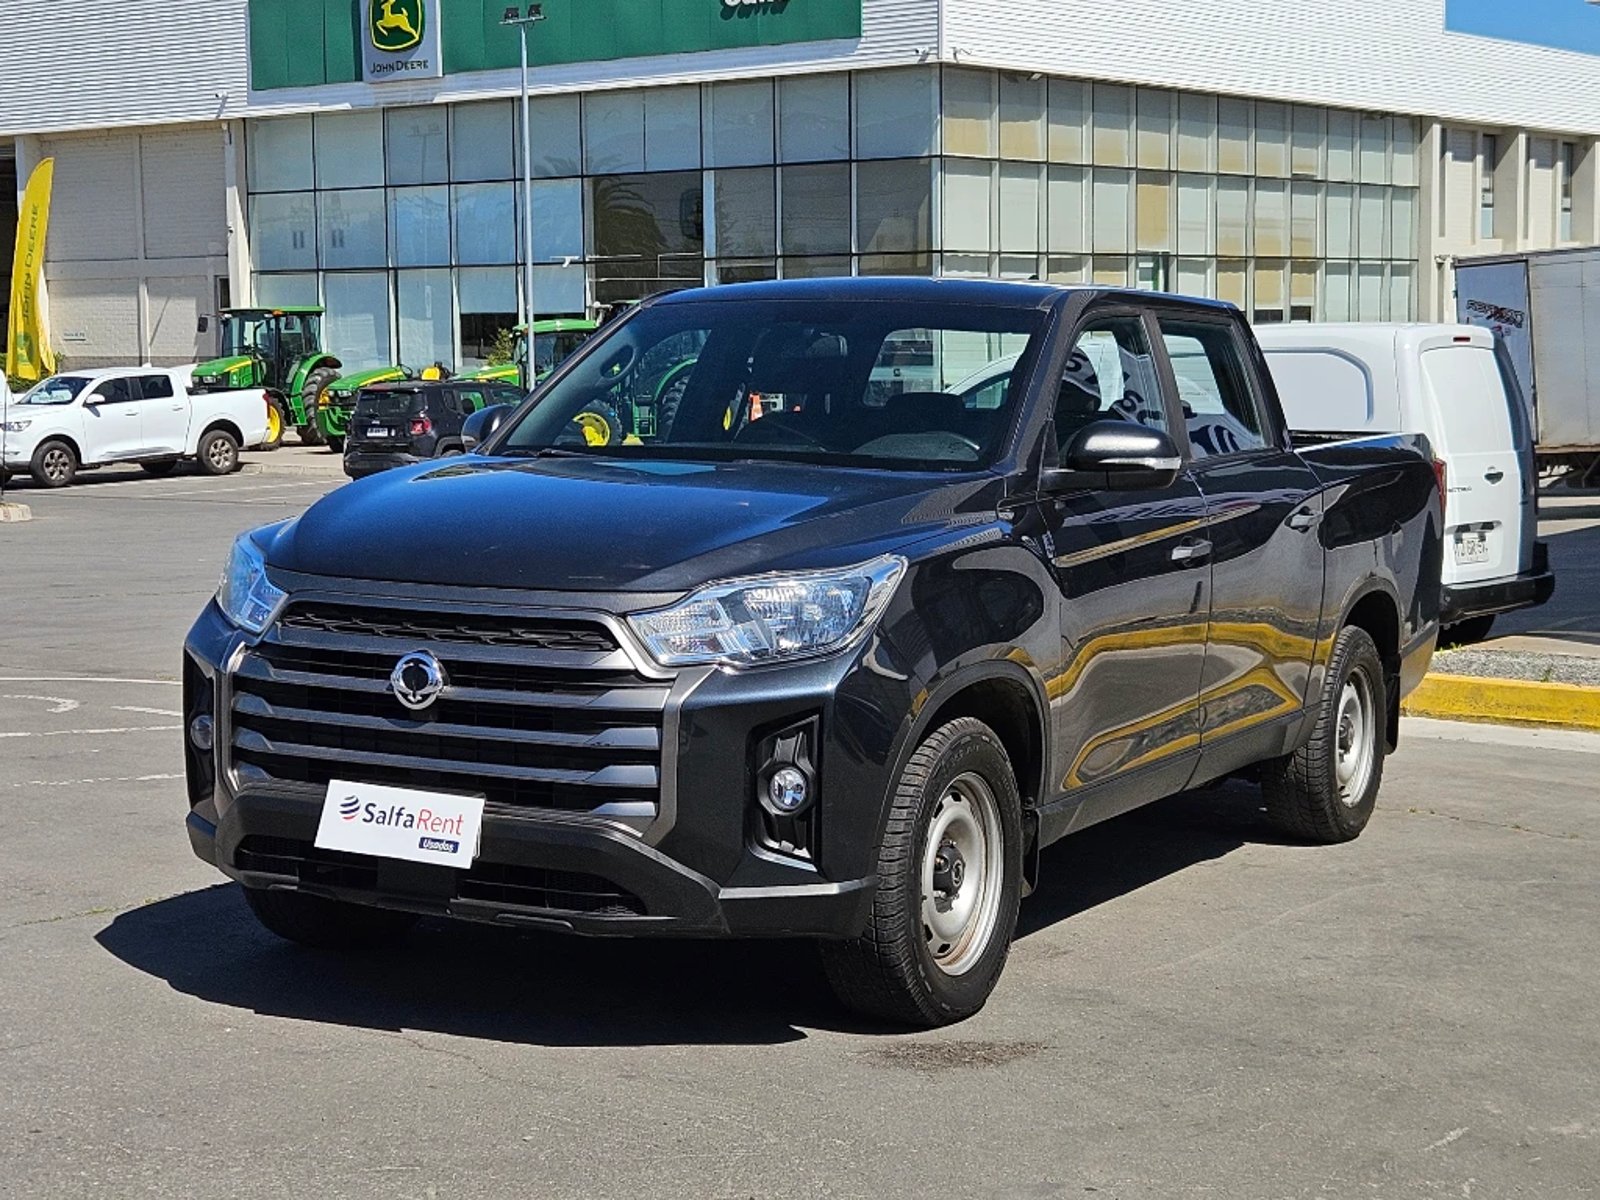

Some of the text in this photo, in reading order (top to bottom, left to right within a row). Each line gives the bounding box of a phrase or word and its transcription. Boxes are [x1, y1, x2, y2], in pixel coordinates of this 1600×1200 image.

[371, 60, 429, 74] JOHN DEERE
[362, 802, 465, 836] SalfaRent
[423, 838, 454, 852] Usados
